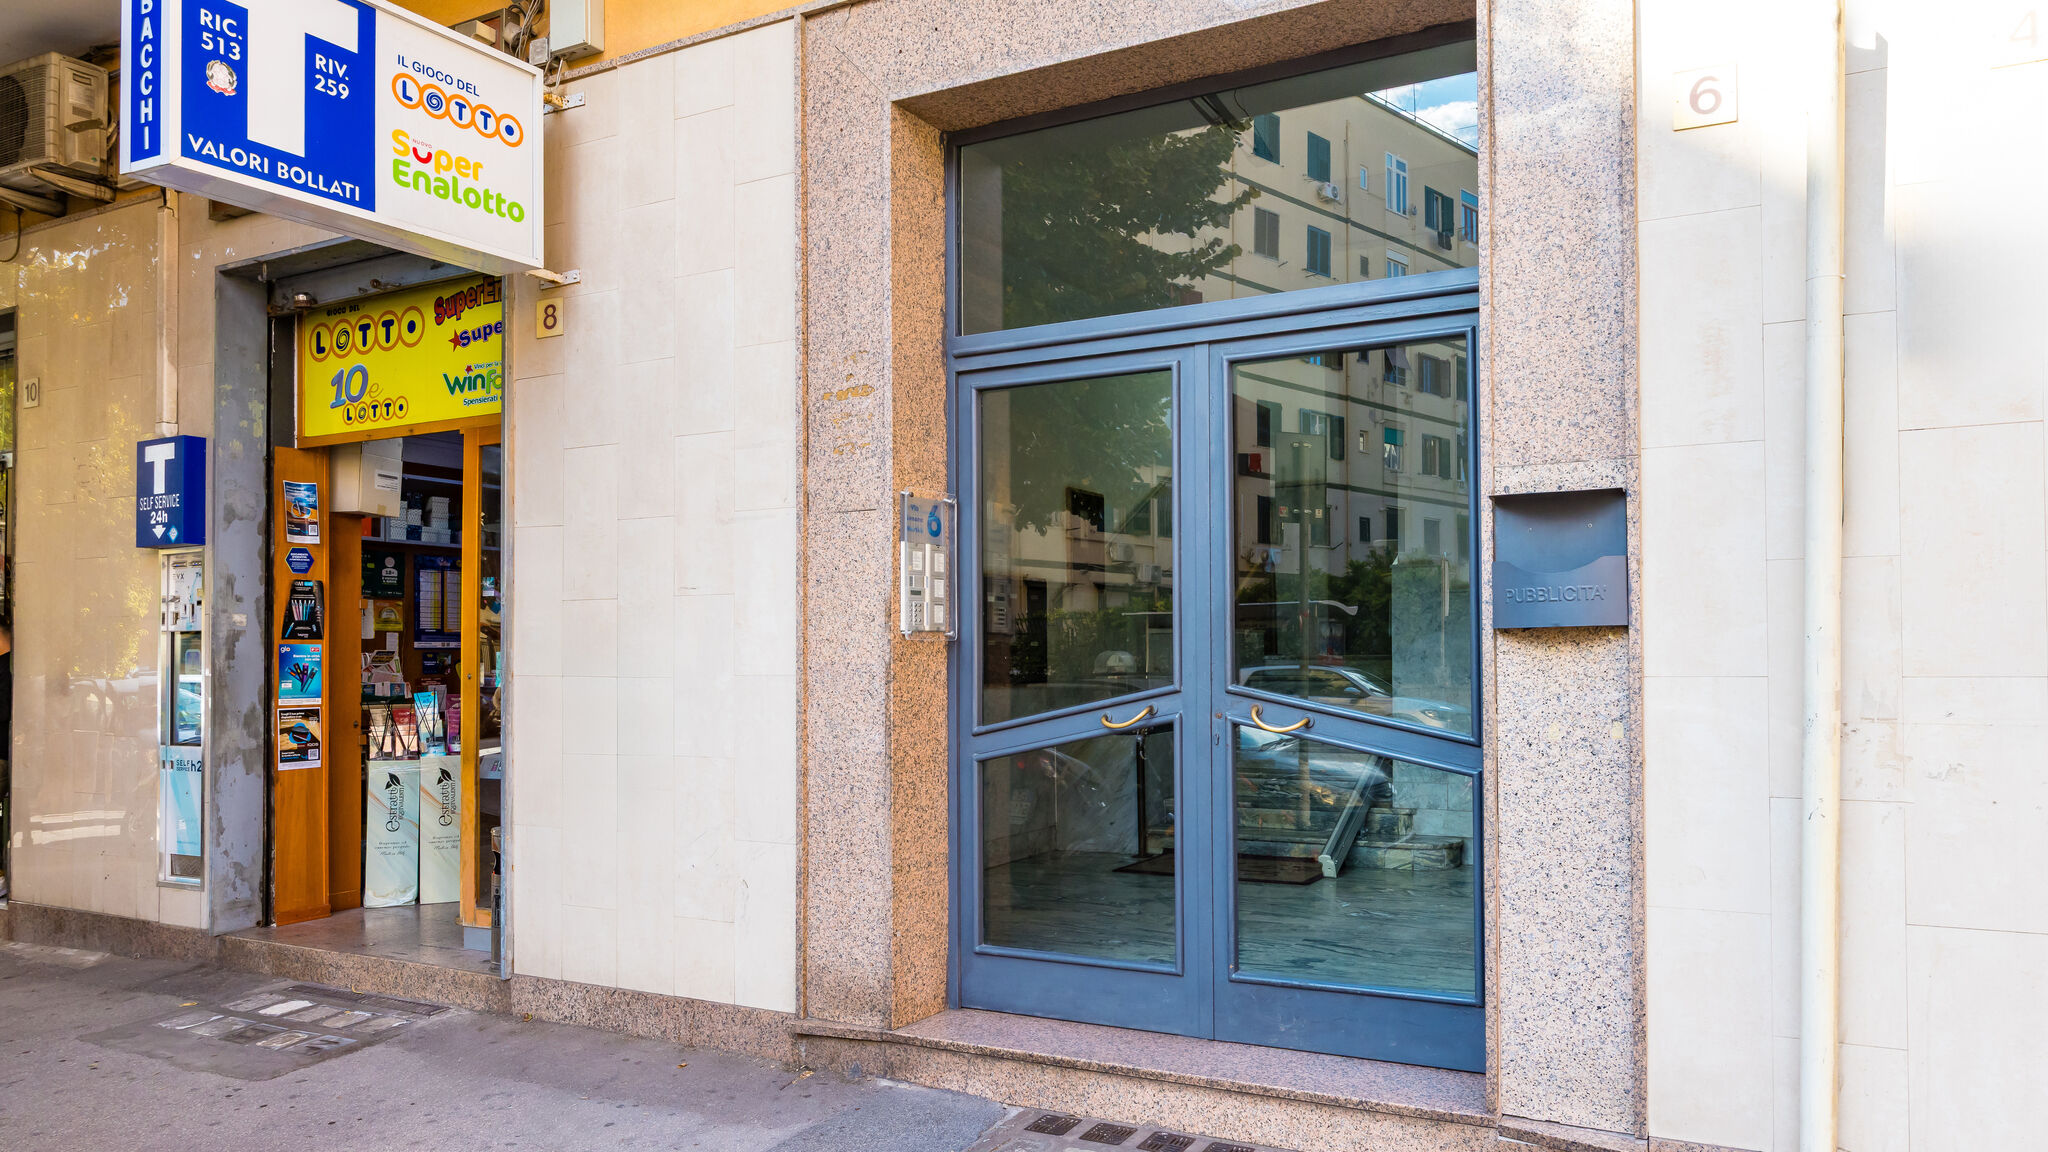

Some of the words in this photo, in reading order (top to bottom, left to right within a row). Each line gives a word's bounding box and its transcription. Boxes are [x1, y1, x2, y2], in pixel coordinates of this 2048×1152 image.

[200, 8, 243, 41] RIC.
[201, 31, 241, 61] 513
[314, 53, 349, 81] RIV.
[397, 54, 409, 68] IL
[412, 61, 454, 86] GIOCO
[457, 79, 480, 97] DEL
[314, 74, 350, 100] 259
[1689, 75, 1722, 115] 6
[391, 73, 524, 148] LOTTO
[187, 133, 269, 174] VALORI
[277, 161, 360, 202] BOLLATI
[392, 129, 484, 181] Super
[392, 158, 525, 223] Enalotto
[309, 305, 426, 362] LOTTO
[543, 304, 557, 330] 8
[24, 382, 38, 403] 10
[342, 395, 409, 425] LOTTO
[144, 442, 176, 495] T
[139, 496, 154, 511] SELF
[154, 494, 180, 510] SERVICE
[150, 511, 168, 524] 24h
[927, 504, 942, 538] 6
